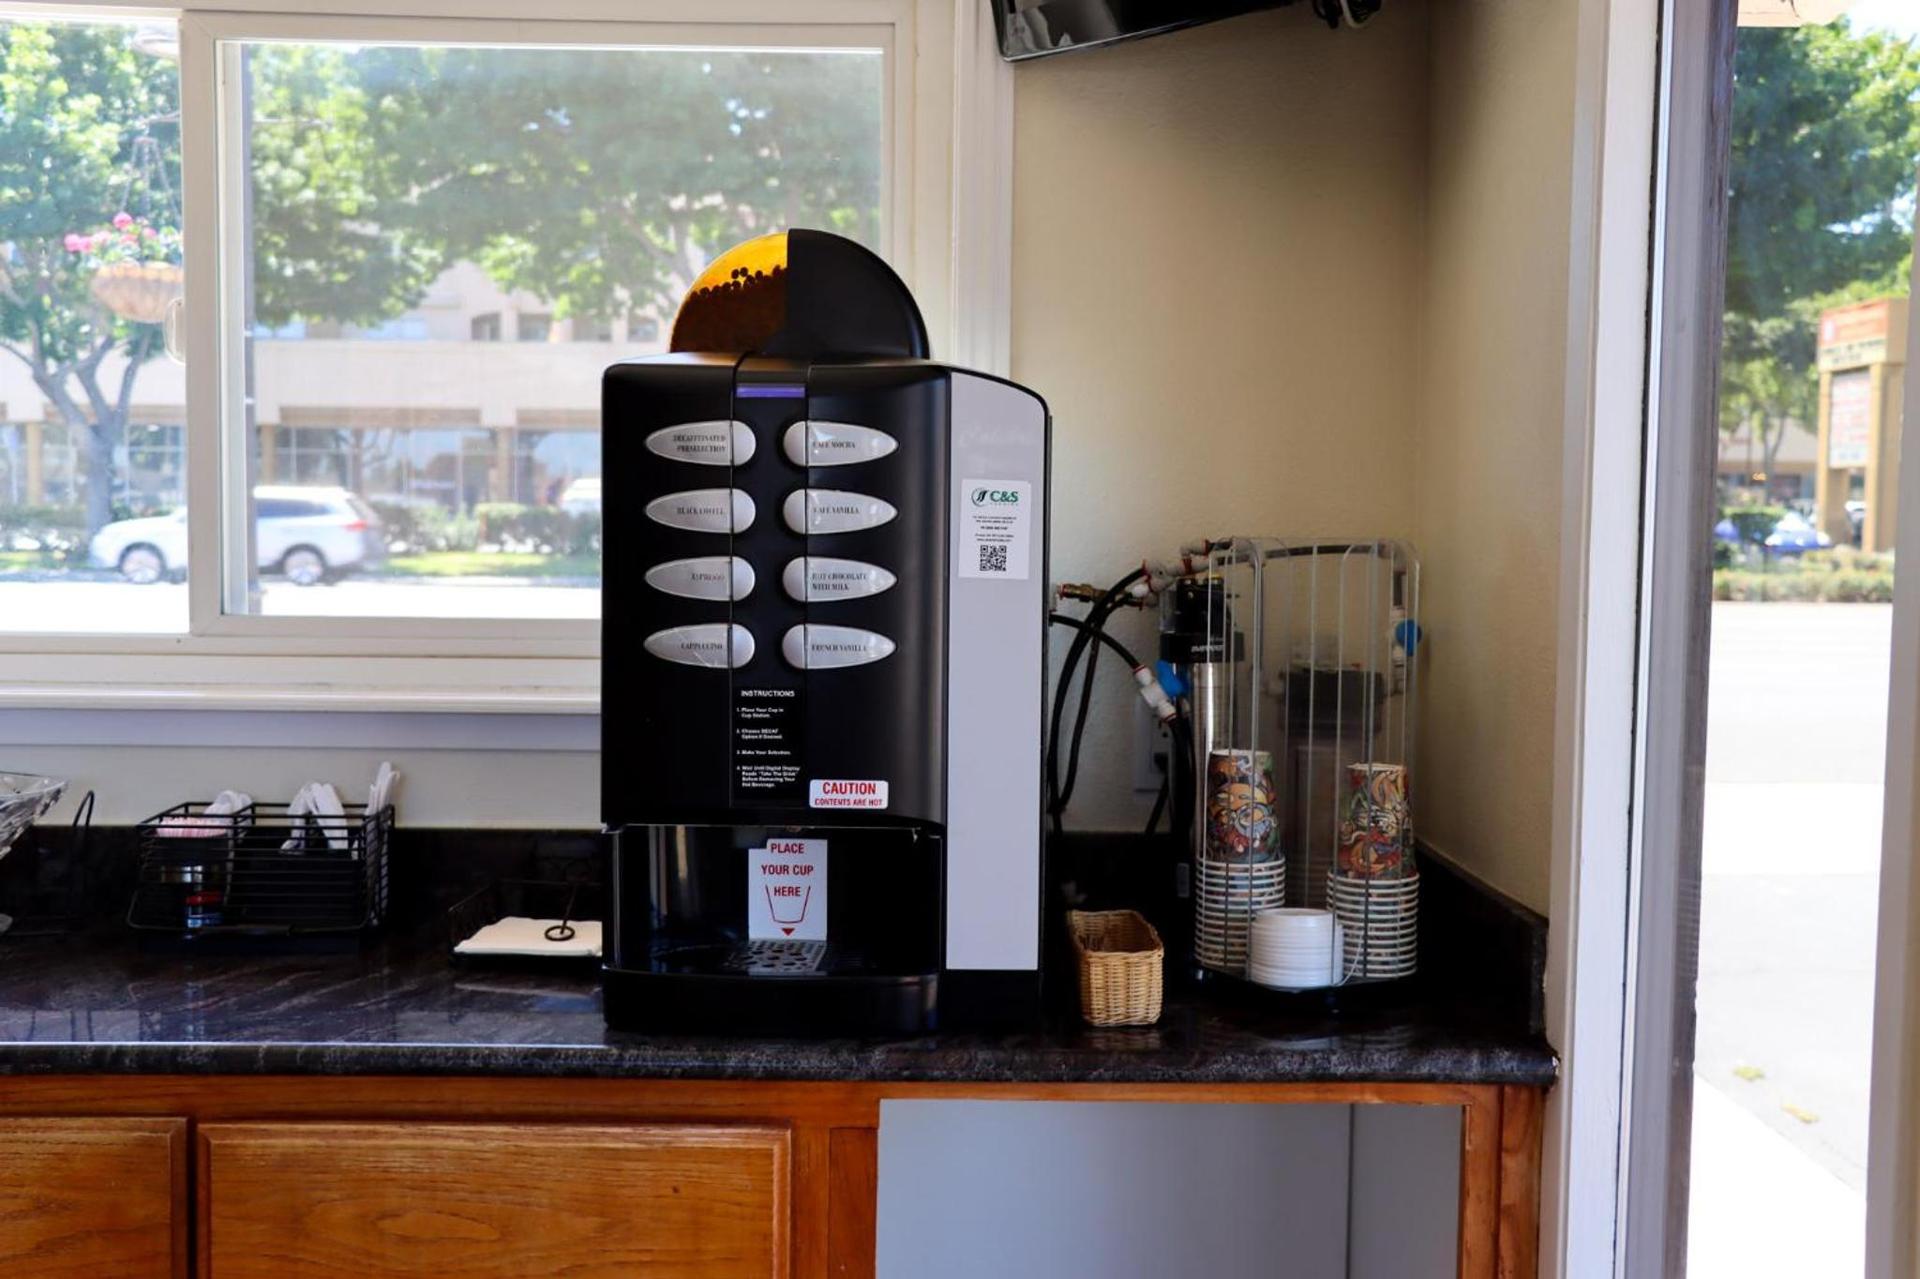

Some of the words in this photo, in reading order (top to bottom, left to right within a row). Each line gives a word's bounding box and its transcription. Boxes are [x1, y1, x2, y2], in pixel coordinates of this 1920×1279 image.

[990, 490, 1019, 503] C&S
[822, 782, 876, 795] CAUTION
[771, 843, 804, 854] PLACE
[761, 864, 789, 875] YOUR
[793, 864, 814, 875] CUP
[773, 886, 801, 897] HERE
